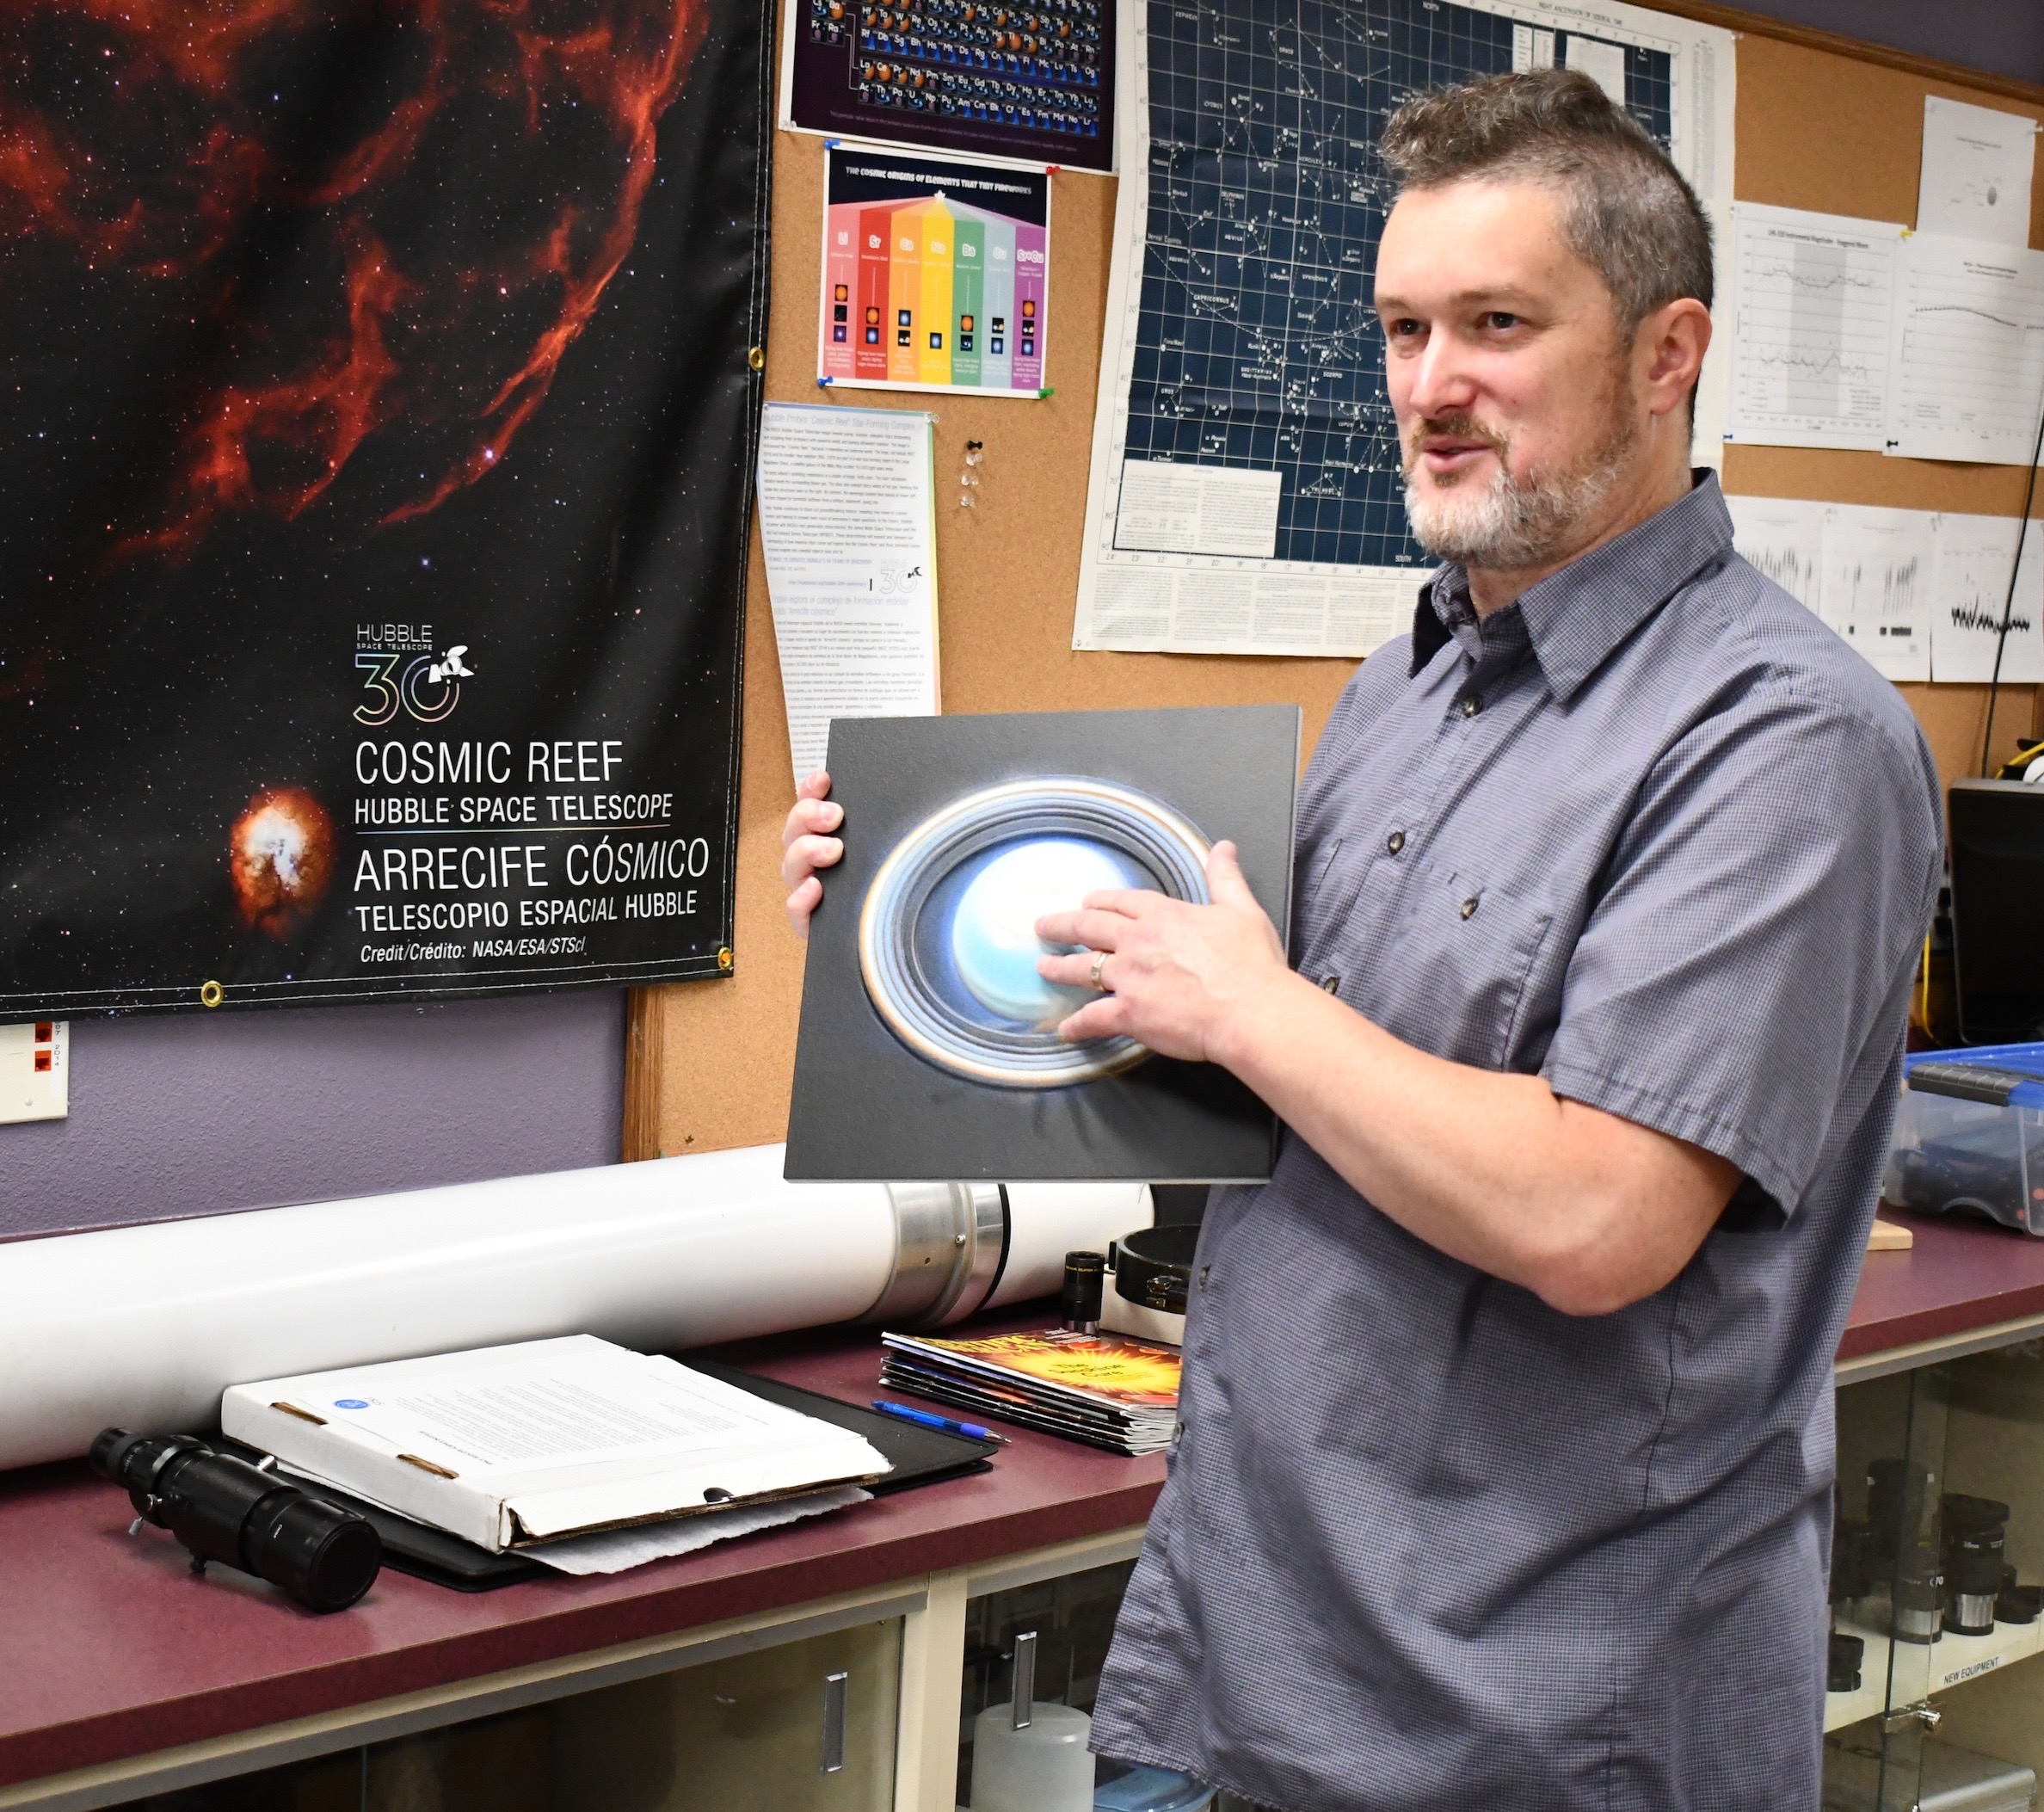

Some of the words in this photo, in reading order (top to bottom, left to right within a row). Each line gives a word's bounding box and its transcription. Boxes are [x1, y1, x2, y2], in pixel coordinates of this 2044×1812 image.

[860, 167, 886, 179] COSMIC
[888, 171, 914, 182] ORIGINS
[916, 174, 925, 182] OF
[961, 180, 978, 189] THAT
[994, 183, 1032, 195] FIREWORKS
[869, 236, 881, 248] Sr
[962, 243, 976, 256] Ba
[1193, 294, 1229, 304] CAPRICORNUS
[356, 624, 433, 643] HUBBLE
[353, 654, 460, 726] 30
[355, 741, 512, 785] COSMIC
[527, 740, 623, 783] REEF
[355, 798, 450, 825] HUBBLE
[459, 797, 537, 823] SPACE
[546, 793, 673, 822] TELESCOPE
[354, 846, 549, 892] ARRECIFE
[566, 835, 710, 886] CÓSMICO
[355, 901, 509, 932] TELESCOPIO
[520, 897, 618, 927] ESPACIAL
[625, 891, 698, 919] HUBBLE
[360, 943, 466, 963] Credit/Crédito:
[472, 936, 586, 958] NASA/ESA/STScI
[1944, 1671, 1960, 1685] NEW
[1961, 1656, 1999, 1679] EQUIPMENT
